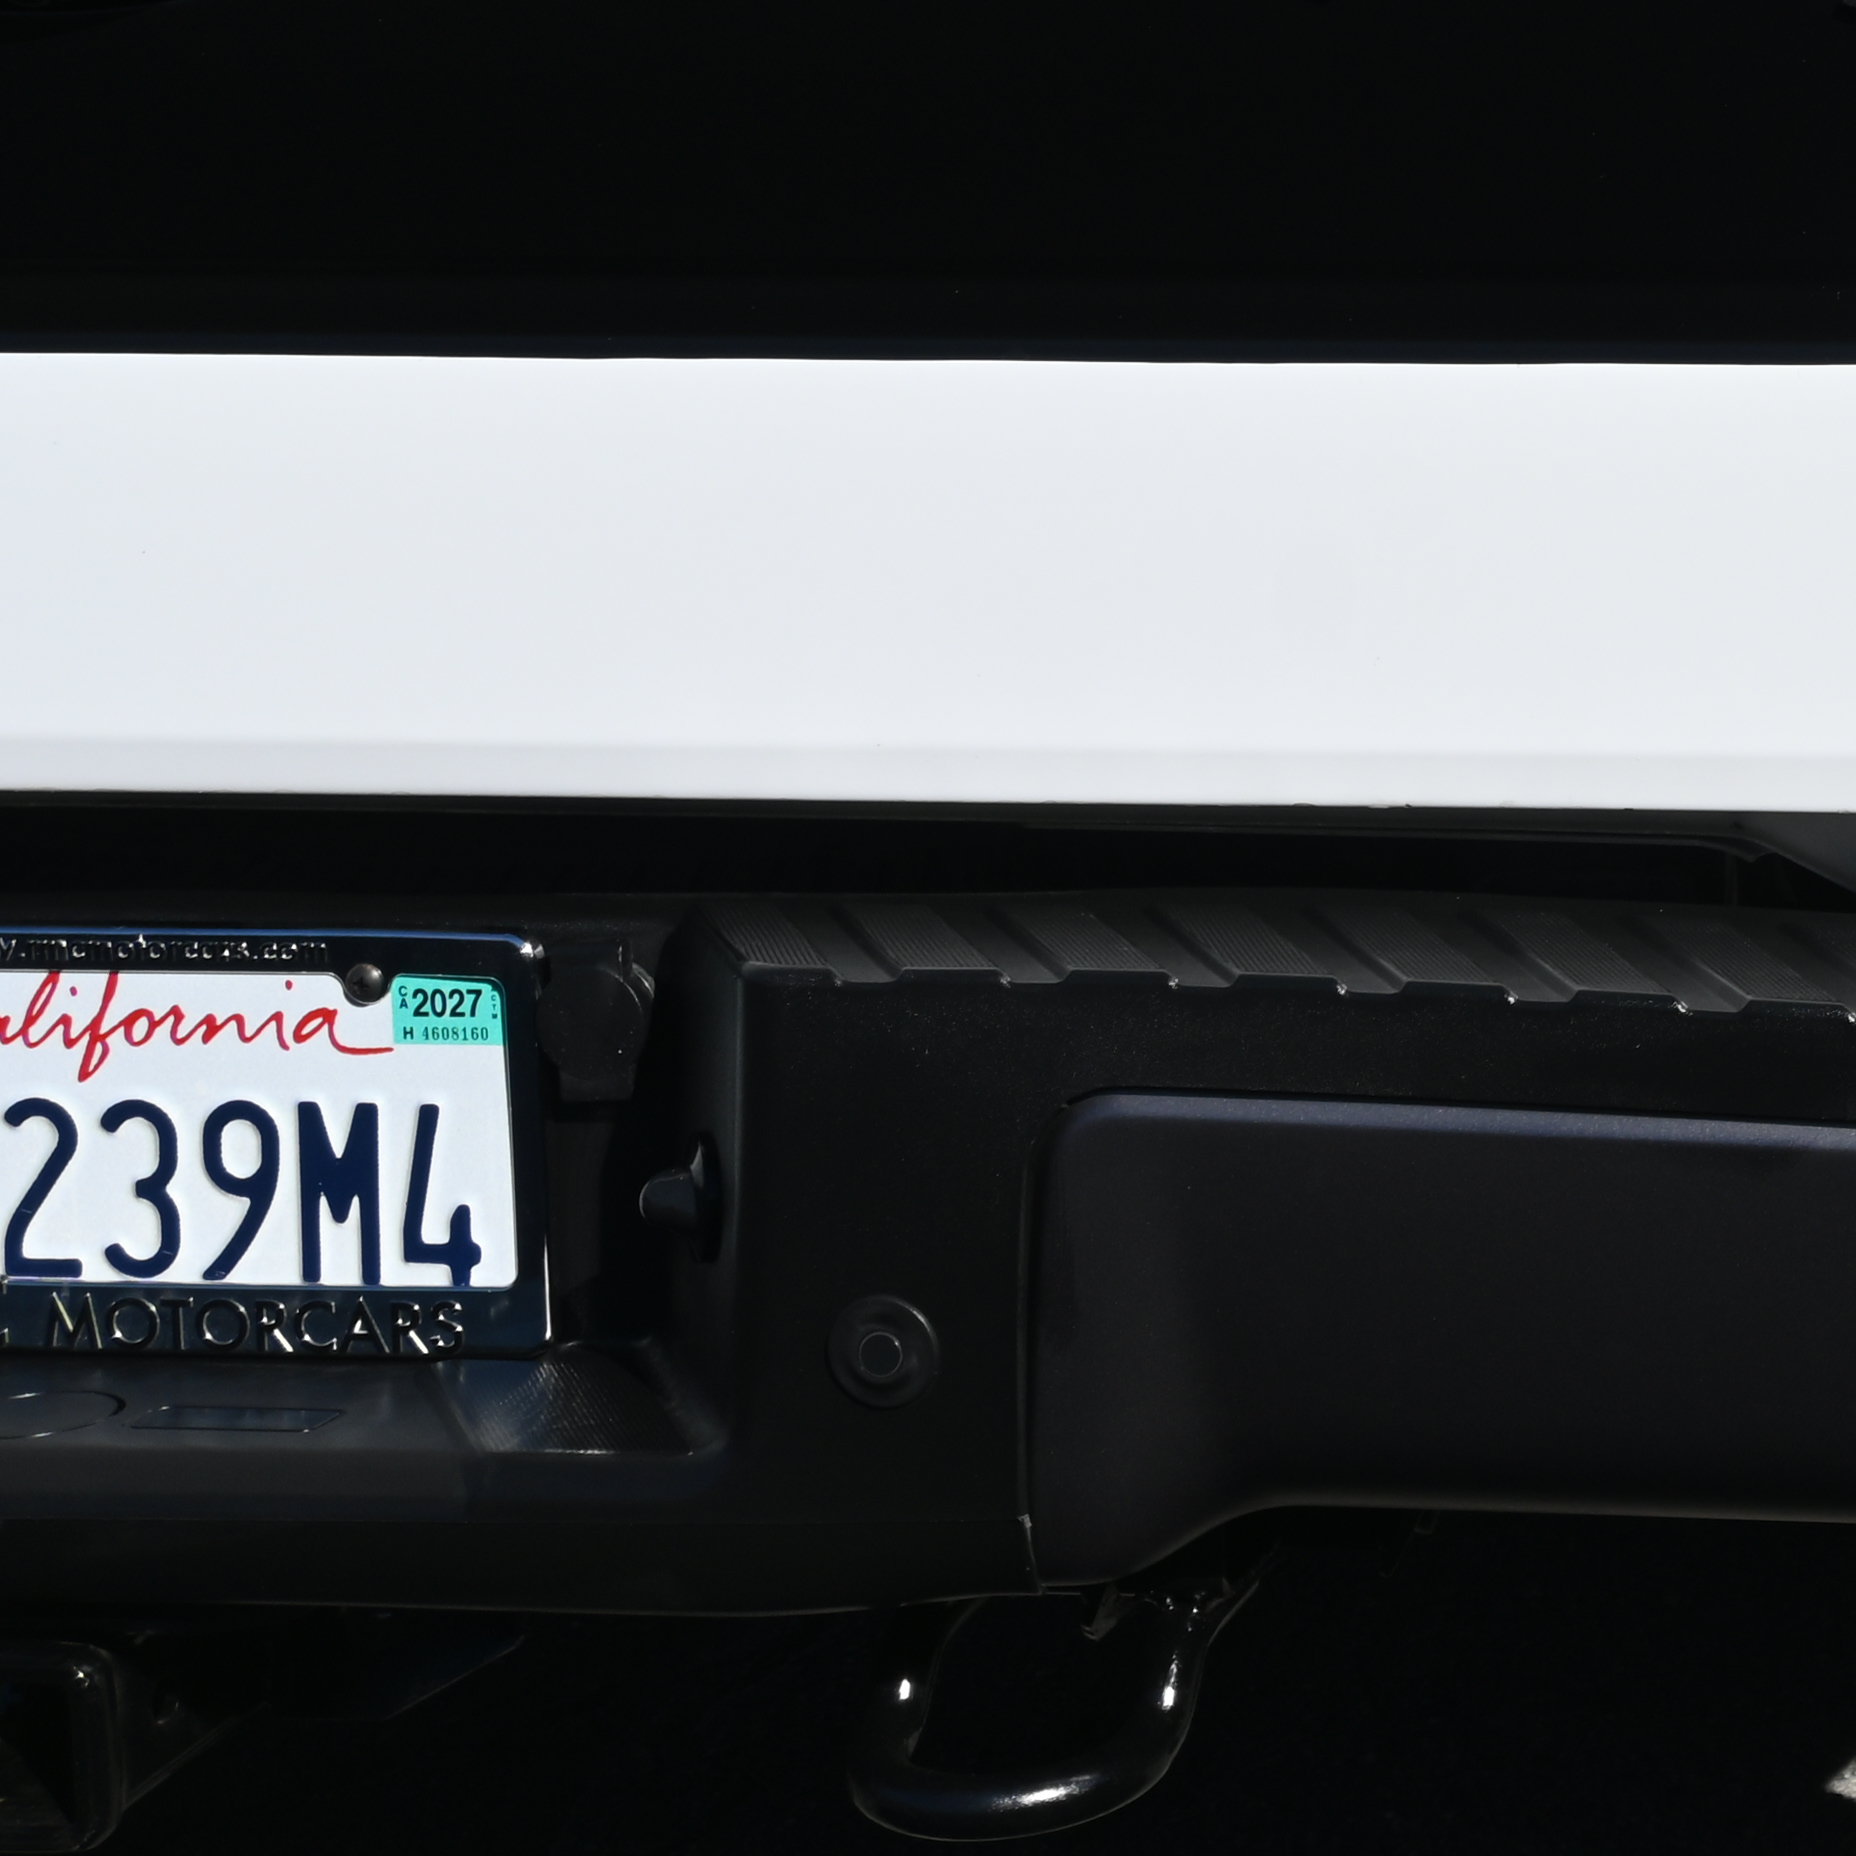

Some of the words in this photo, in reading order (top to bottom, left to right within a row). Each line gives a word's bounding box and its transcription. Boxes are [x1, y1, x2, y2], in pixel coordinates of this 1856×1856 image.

[412, 988, 482, 1018] 2027
[403, 1027, 413, 1040] H
[422, 1027, 489, 1041] 4608160
[3, 1097, 481, 1285] 239M4
[49, 1292, 464, 1354] MOTORCARS
